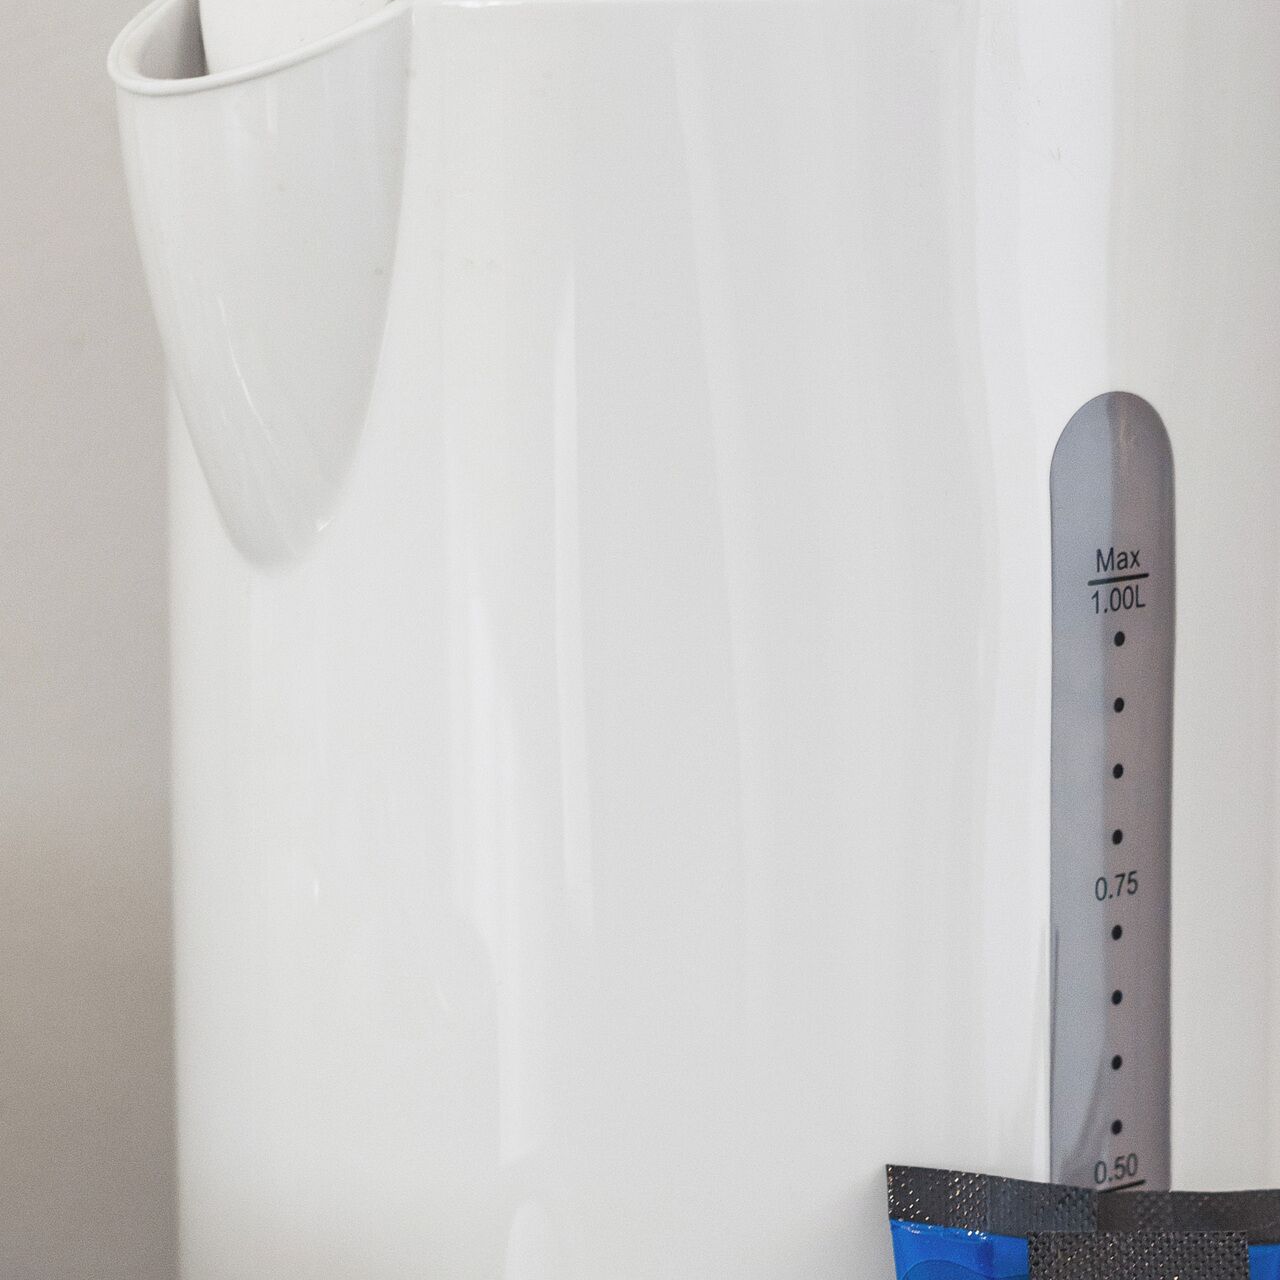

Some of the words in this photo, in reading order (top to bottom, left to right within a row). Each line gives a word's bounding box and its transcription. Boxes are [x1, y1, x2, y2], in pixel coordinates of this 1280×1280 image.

[1096, 547, 1141, 573] Max
[1091, 585, 1146, 614] 1.00L
[1095, 870, 1139, 901] 0.75
[1094, 1153, 1138, 1184] 0.50
